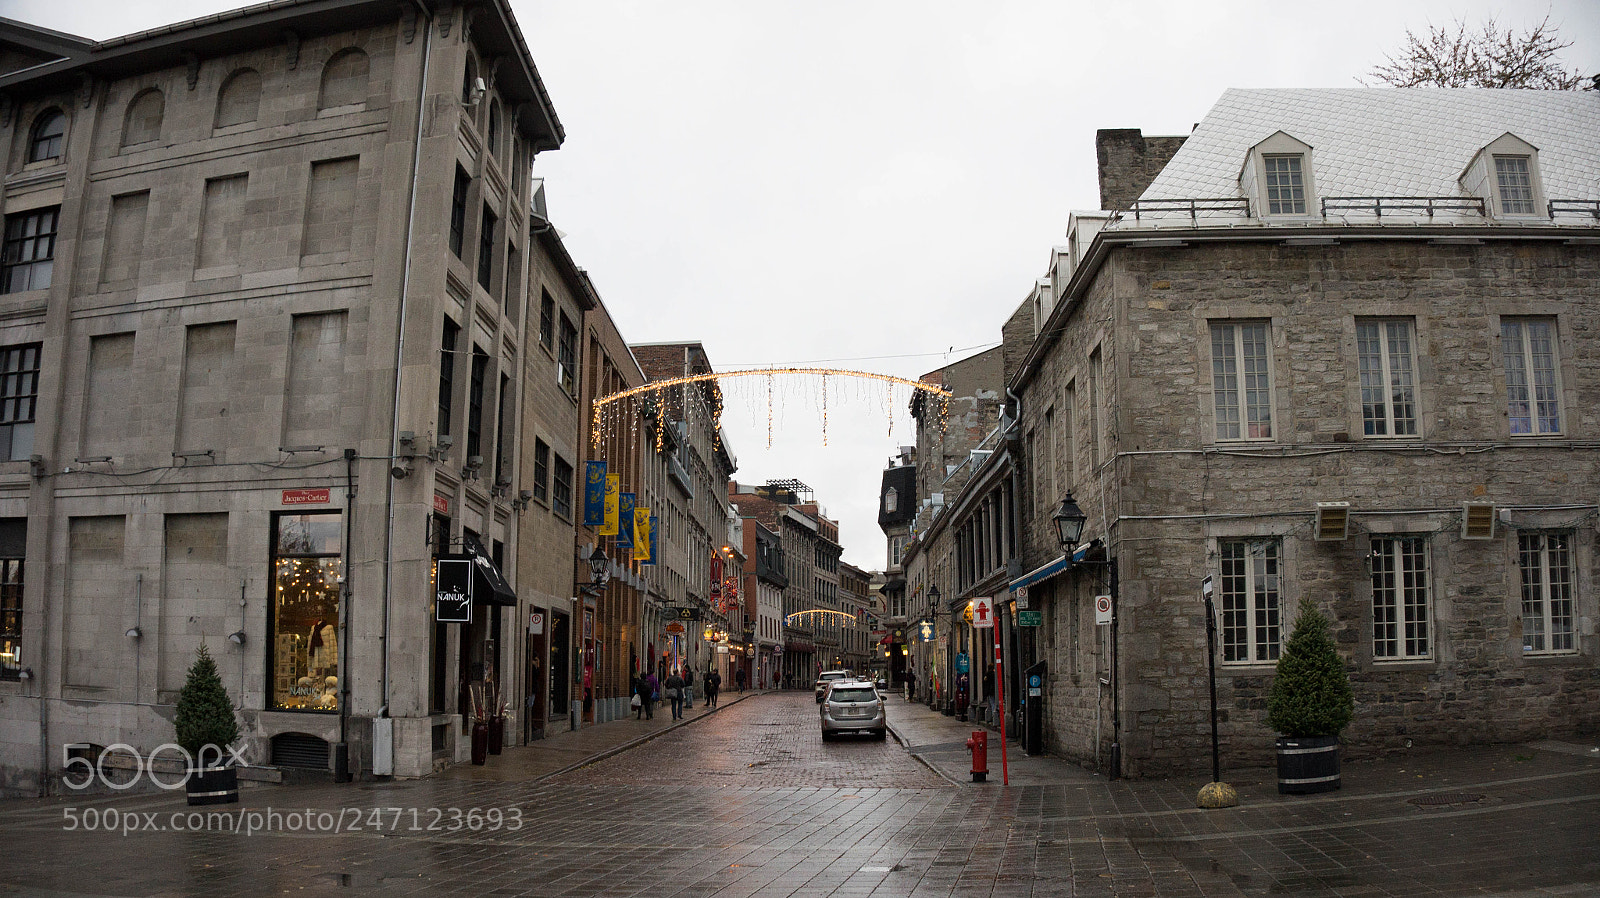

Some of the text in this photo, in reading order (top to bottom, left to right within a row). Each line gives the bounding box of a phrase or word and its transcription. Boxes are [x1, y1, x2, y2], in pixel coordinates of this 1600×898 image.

[285, 494, 328, 504] Jacques-Cartier
[437, 593, 465, 601] NANUK
[289, 686, 318, 696] NANUK
